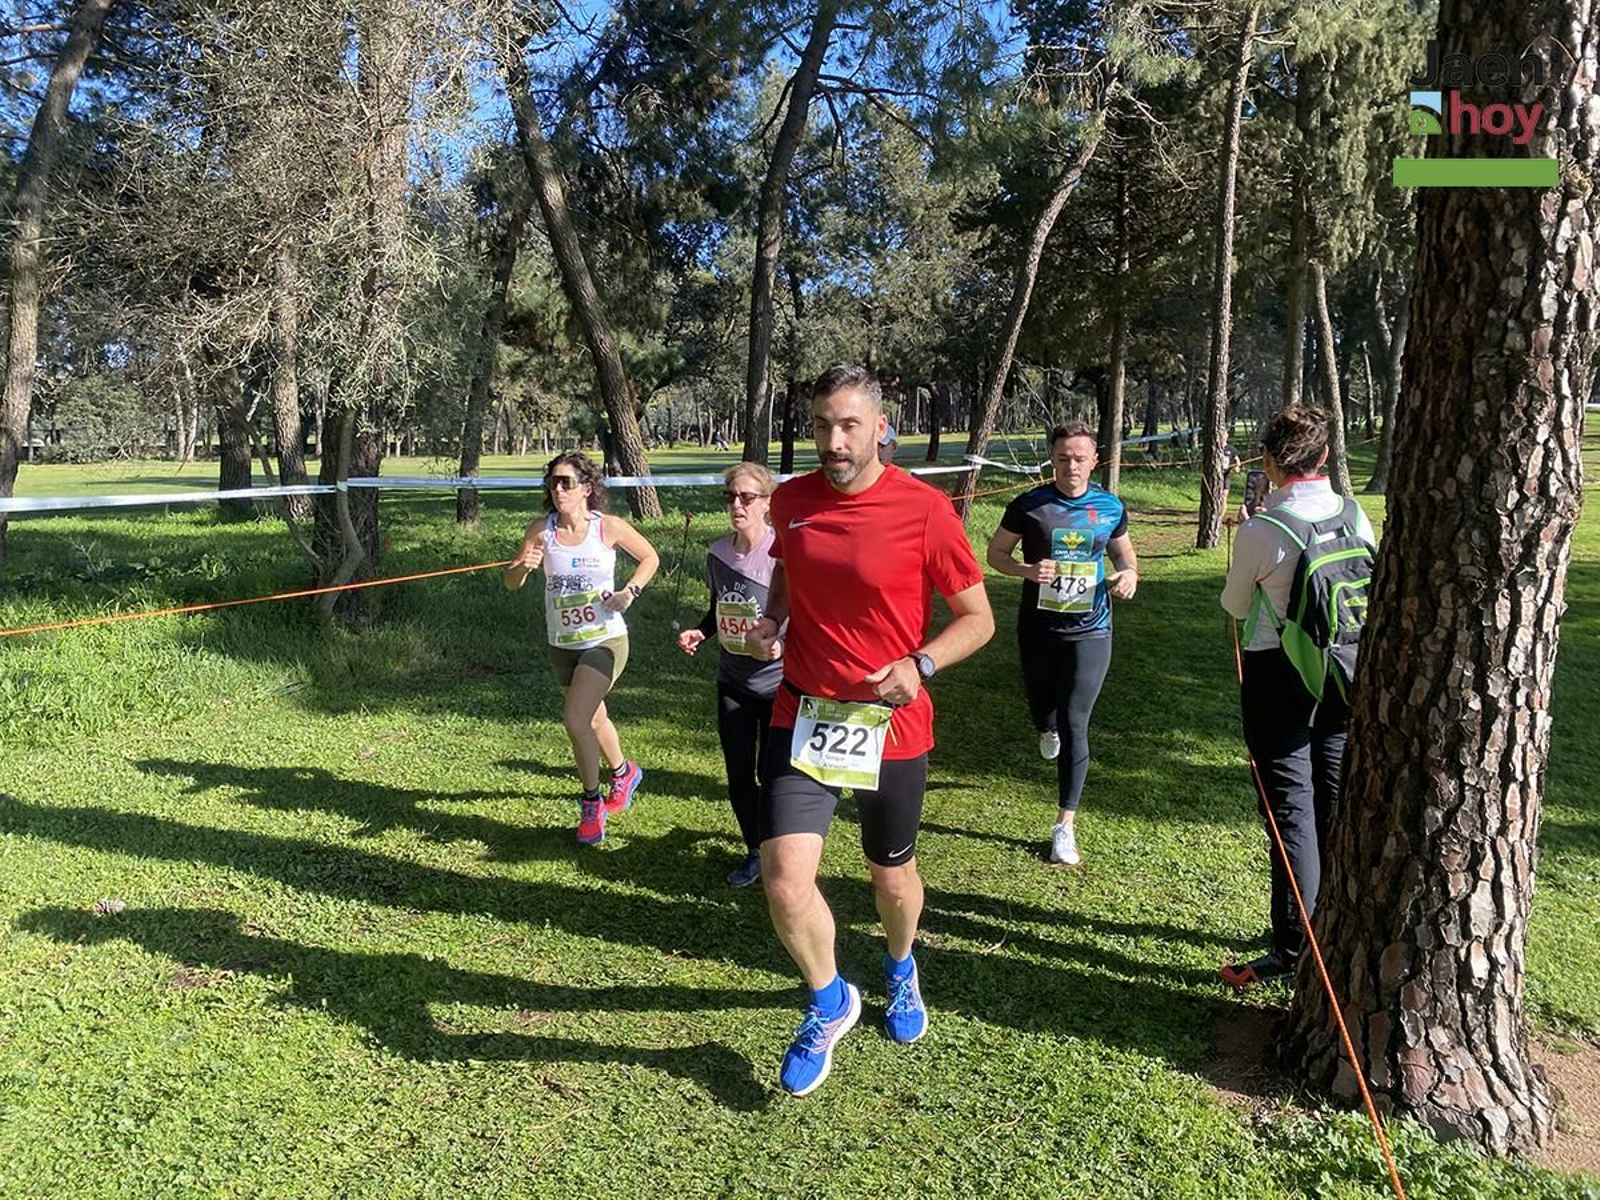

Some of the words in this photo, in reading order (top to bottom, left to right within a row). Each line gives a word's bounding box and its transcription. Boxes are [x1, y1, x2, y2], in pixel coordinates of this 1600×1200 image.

[733, 581, 747, 594] DE
[1050, 575, 1087, 595] 478
[561, 605, 596, 627] 536
[720, 616, 748, 635] 454
[809, 722, 869, 757] 522
